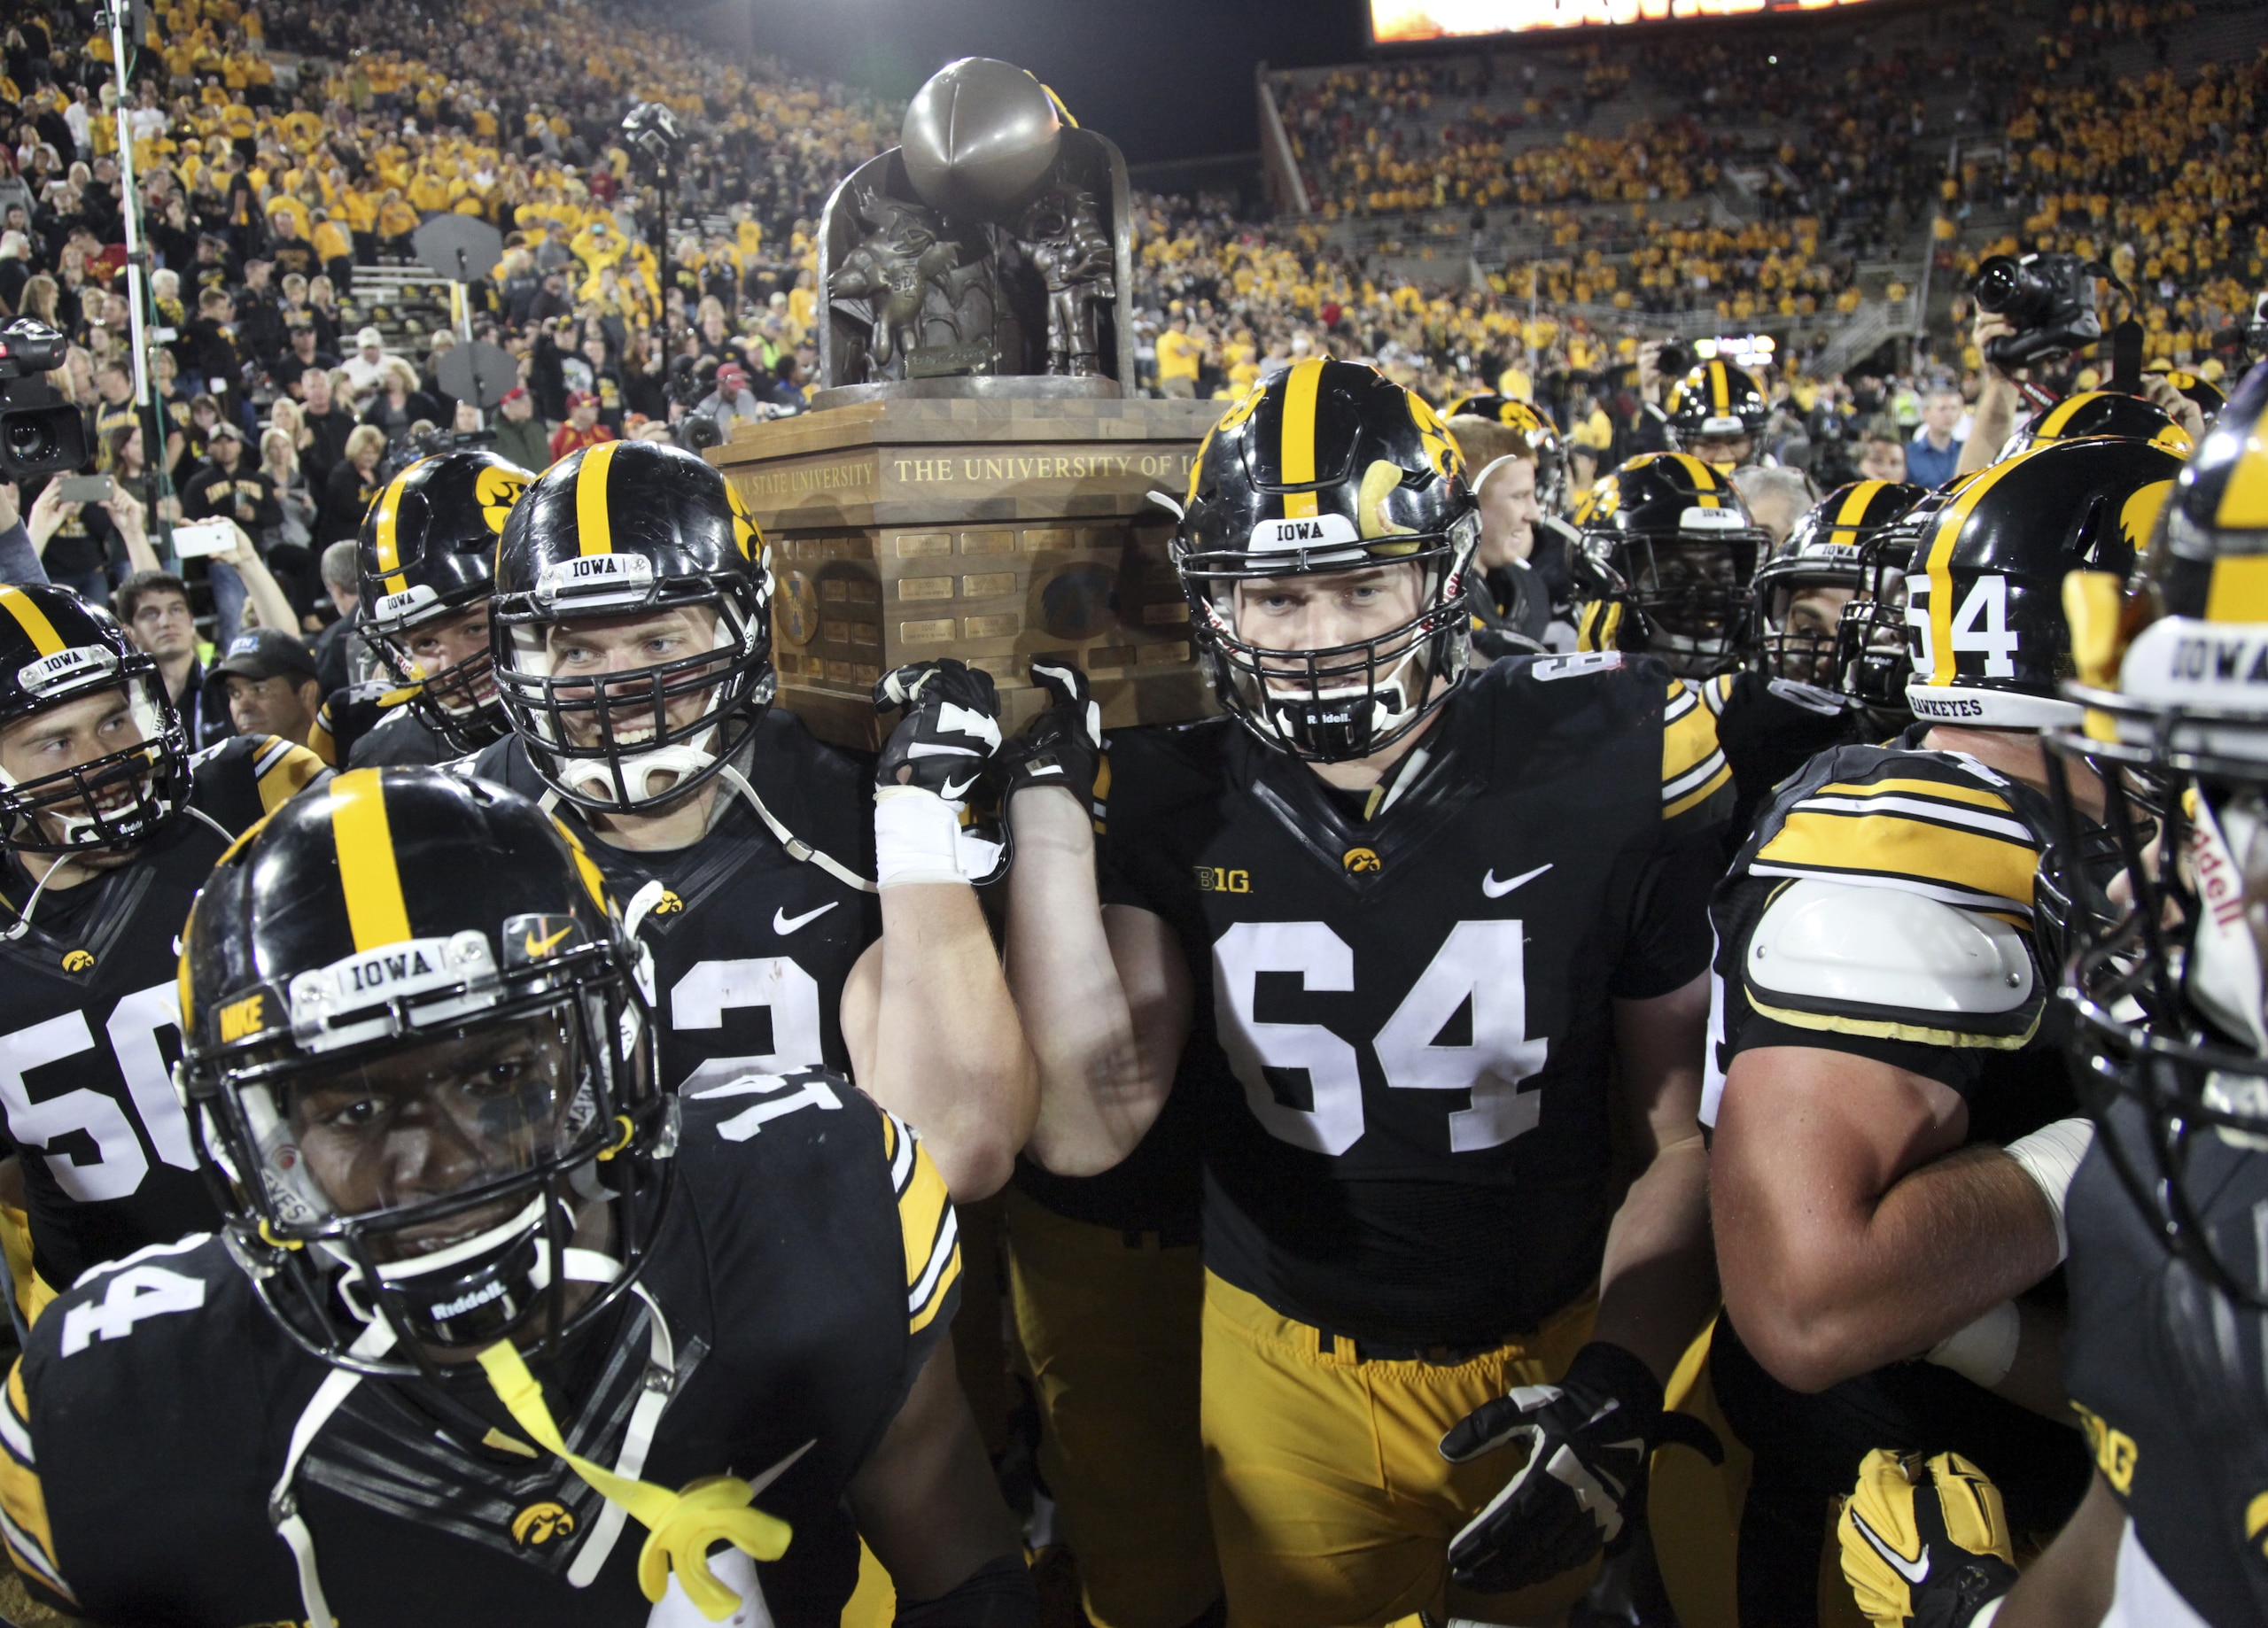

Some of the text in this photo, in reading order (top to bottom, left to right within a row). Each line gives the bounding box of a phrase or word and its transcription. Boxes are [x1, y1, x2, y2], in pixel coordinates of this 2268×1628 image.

[753, 472, 787, 496] STATE
[791, 462, 873, 492] UNIVERSITY
[894, 460, 953, 482] THE
[963, 455, 1132, 480] UNIVERSITY
[1140, 455, 1172, 477] OF
[1278, 522, 1324, 541] IOWA
[1822, 544, 1855, 558] IOWA
[572, 557, 617, 578] IOWA
[386, 592, 415, 610] IOWA
[1905, 574, 2019, 678] 54
[43, 651, 83, 673] IOWA
[1911, 695, 1983, 717] HAWKEYES
[350, 950, 432, 991] IOWA
[220, 993, 264, 1043] NIKE
[1213, 919, 1549, 1157] 64
[0, 979, 200, 1203] 50
